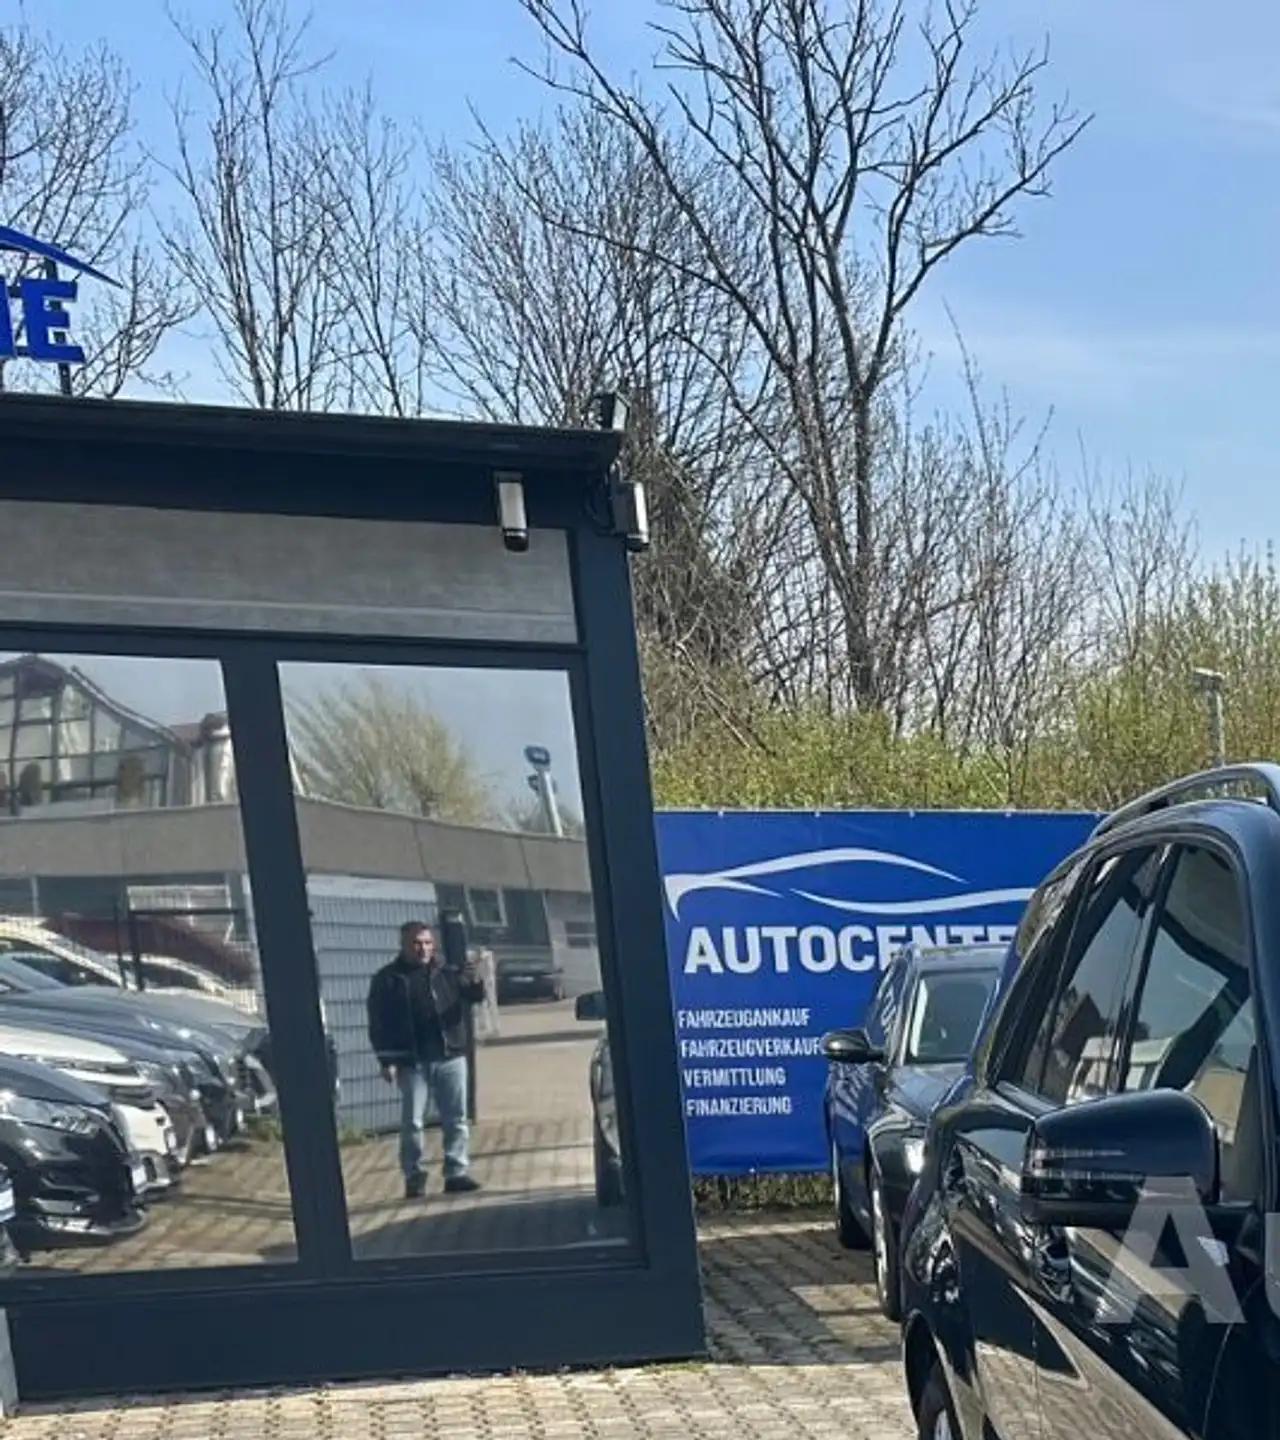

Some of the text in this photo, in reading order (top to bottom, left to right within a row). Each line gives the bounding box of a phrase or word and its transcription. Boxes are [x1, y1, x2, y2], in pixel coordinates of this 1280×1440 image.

[677, 1008, 811, 1029] FAHRZEUGANKAUF
[680, 1036, 825, 1058] FAHRZEUGVERKAUF
[683, 1067, 786, 1088] VERMITTLUNG
[686, 1096, 793, 1117] FINANZIERUNG
